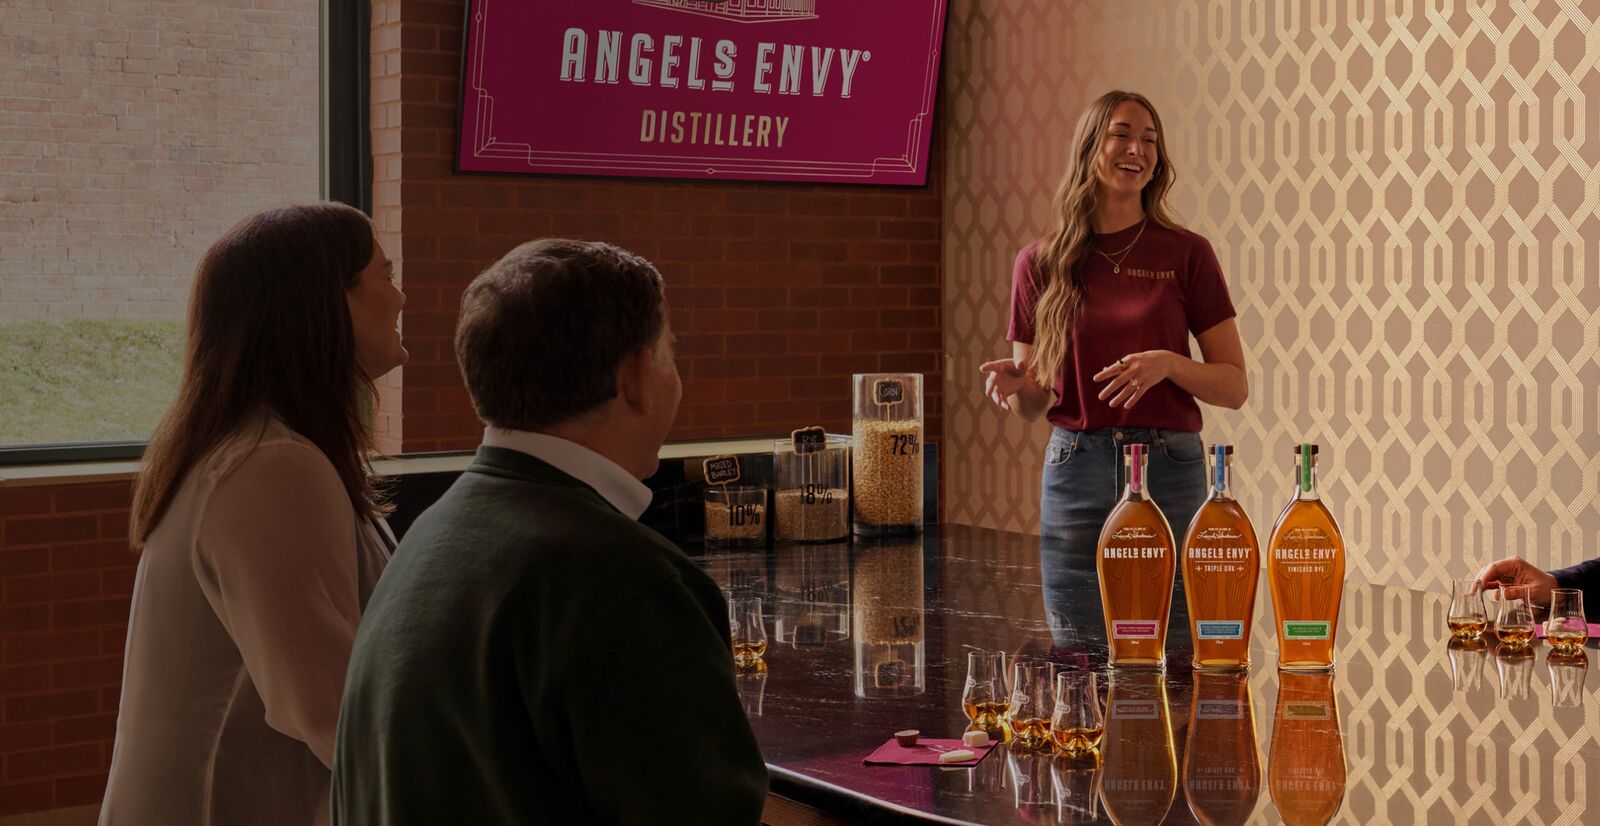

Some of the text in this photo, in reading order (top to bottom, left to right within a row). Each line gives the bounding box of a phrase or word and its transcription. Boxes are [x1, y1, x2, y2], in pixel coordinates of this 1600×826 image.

[560, 27, 737, 93] ANGELS
[640, 109, 789, 148] DISTILLERY
[891, 434, 920, 456] 72%
[711, 467, 737, 479] BARLEY
[728, 503, 760, 527] 10%
[1103, 547, 1139, 559] ANGELS
[1188, 547, 1224, 559] ANGELS
[1275, 548, 1311, 560] ANGELS
